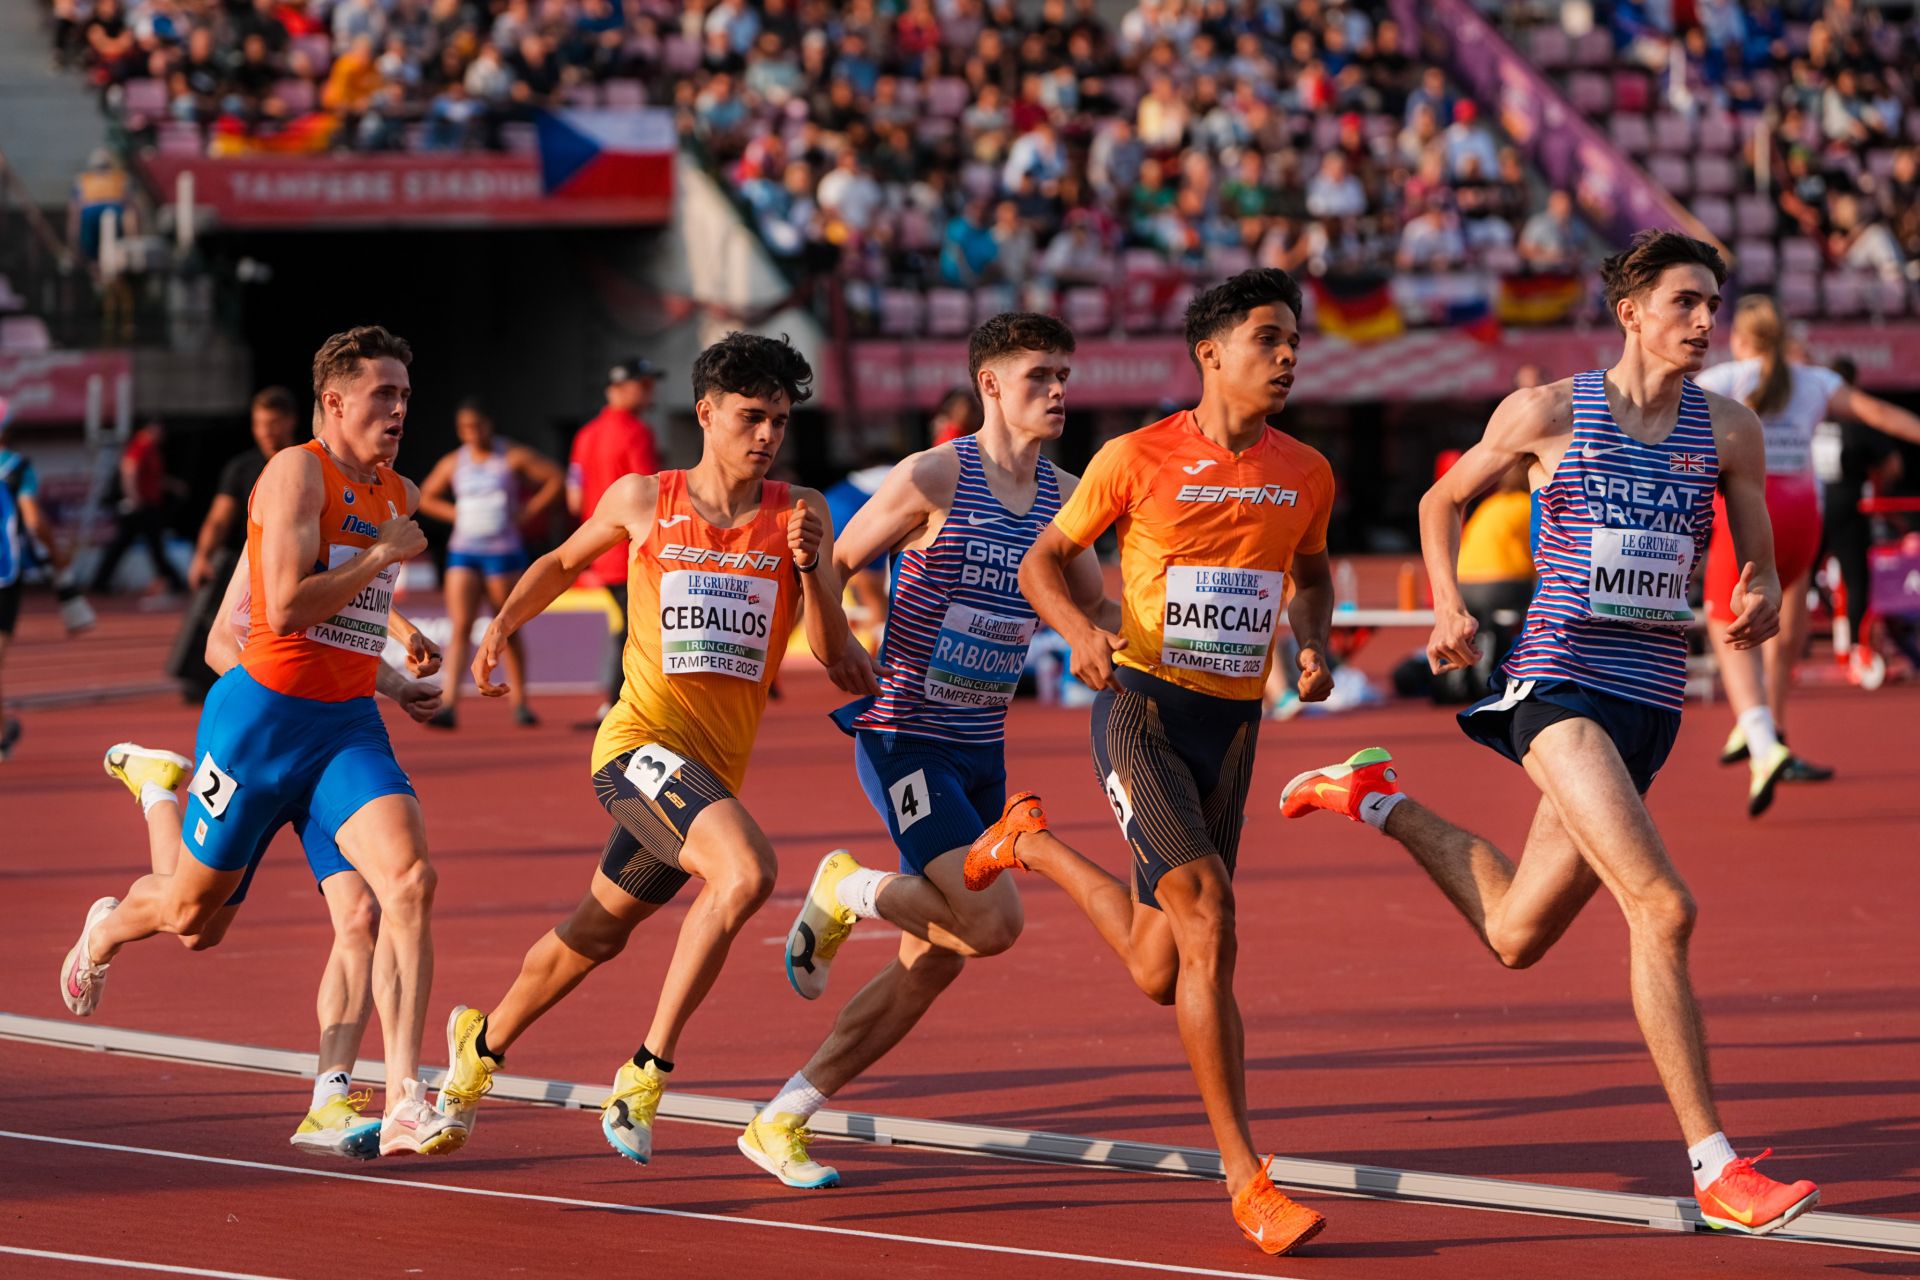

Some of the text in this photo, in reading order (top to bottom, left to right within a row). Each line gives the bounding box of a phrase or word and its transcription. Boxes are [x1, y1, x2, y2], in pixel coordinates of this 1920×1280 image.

[1175, 484, 1299, 507] ESPAÑA
[1584, 474, 1699, 510] GREAT
[1587, 501, 1696, 534] BRITAIN
[1622, 534, 1679, 553] LE GRUYÈRE
[658, 544, 783, 572] ESPAÑA
[688, 575, 749, 593] LE GRUYÈRE
[1196, 571, 1259, 588] LE GRUYÈRE
[1595, 567, 1683, 599] MIRFIN
[690, 589, 746, 600] SWITZERLAND
[1198, 586, 1257, 596] SWITZERLAND
[661, 606, 767, 639] CEBALLOS
[970, 613, 985, 629] LE
[1166, 601, 1272, 634] BARCALA
[1620, 606, 1643, 618] RUN
[339, 617, 360, 630] RUN
[313, 625, 370, 651] TAMPERE
[692, 641, 715, 652] RUN
[716, 644, 746, 655] CLEAN
[1195, 640, 1221, 652] RUN
[1222, 643, 1254, 655] CLEAN
[669, 655, 759, 677] TAMPERE 2025
[935, 635, 1026, 675] RABJOHNS
[1169, 651, 1260, 673] TAMPERE 2025
[953, 676, 973, 688] RUN
[974, 678, 1000, 691] CLEAN
[929, 683, 1008, 707] TAMPERE 2025
[636, 755, 666, 784] 3
[201, 770, 220, 808] 2
[901, 783, 919, 817] 4
